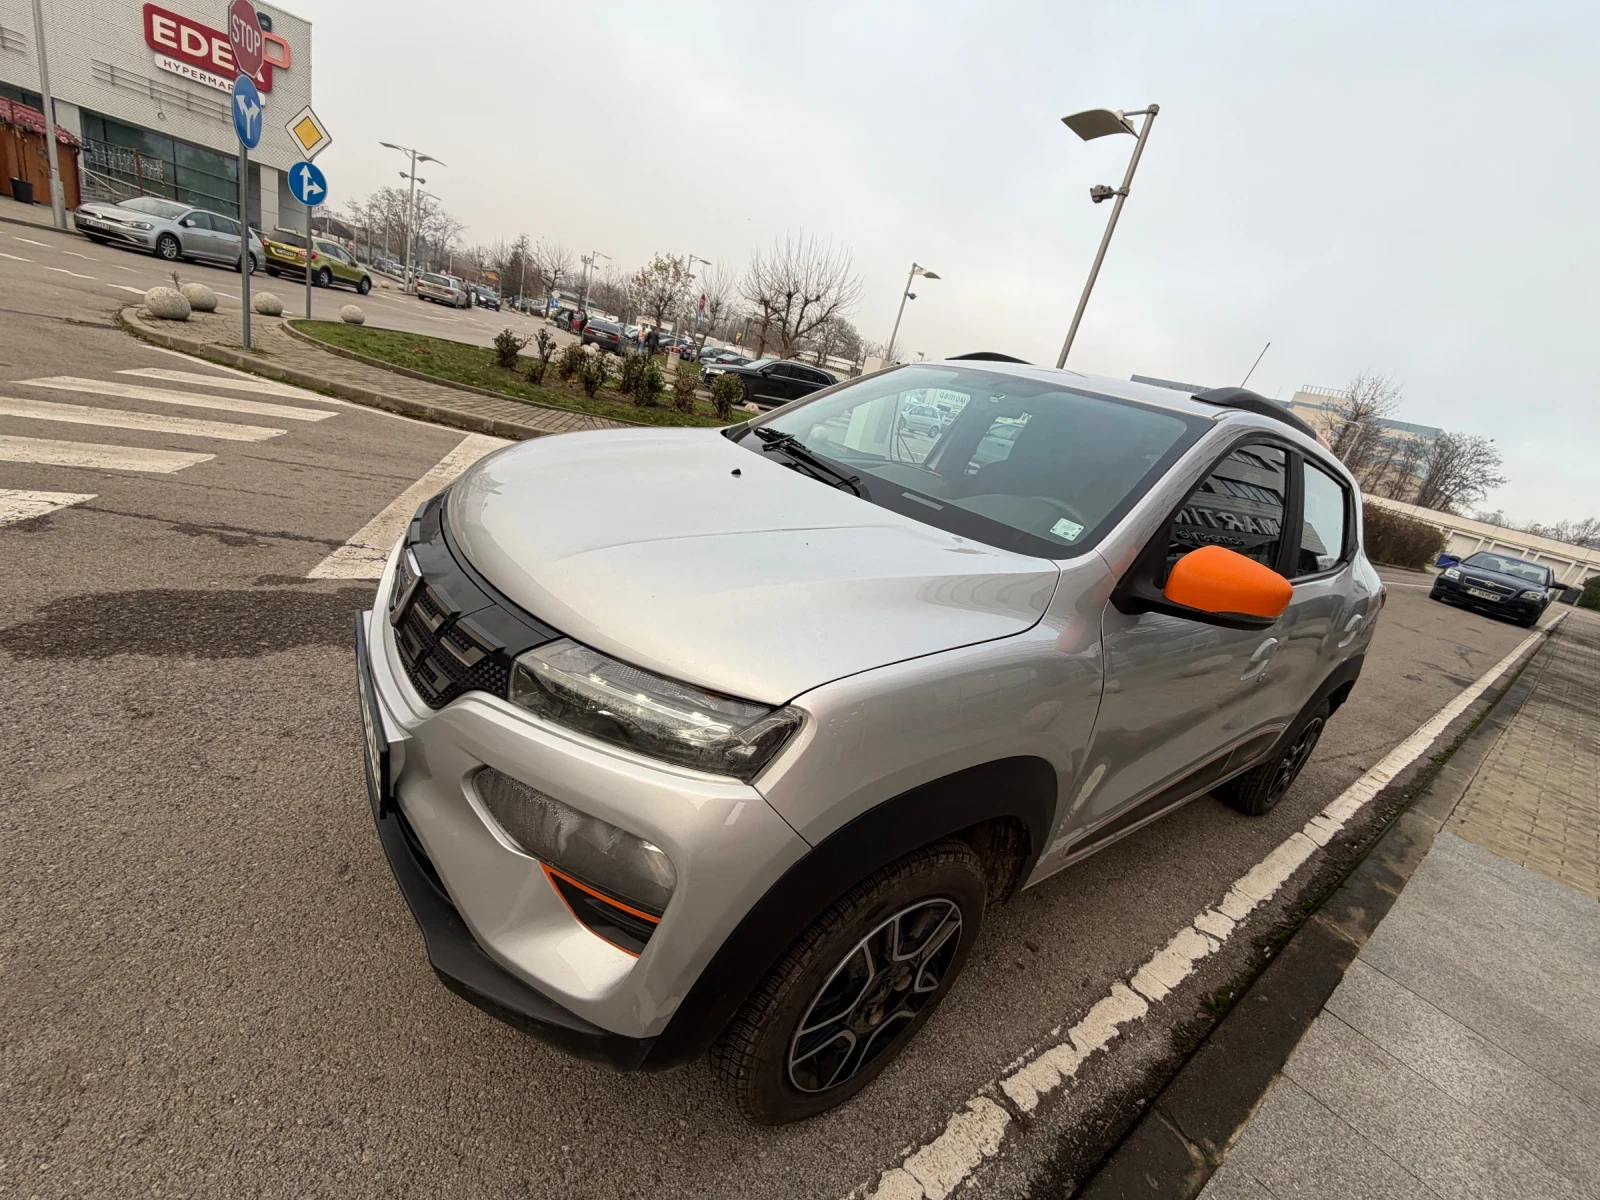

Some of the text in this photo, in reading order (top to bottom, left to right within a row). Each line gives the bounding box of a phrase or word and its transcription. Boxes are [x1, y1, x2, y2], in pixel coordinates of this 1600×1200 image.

[151, 14, 265, 83] EDE
[232, 14, 260, 56] STOP
[163, 59, 234, 91] HYPERMAR
